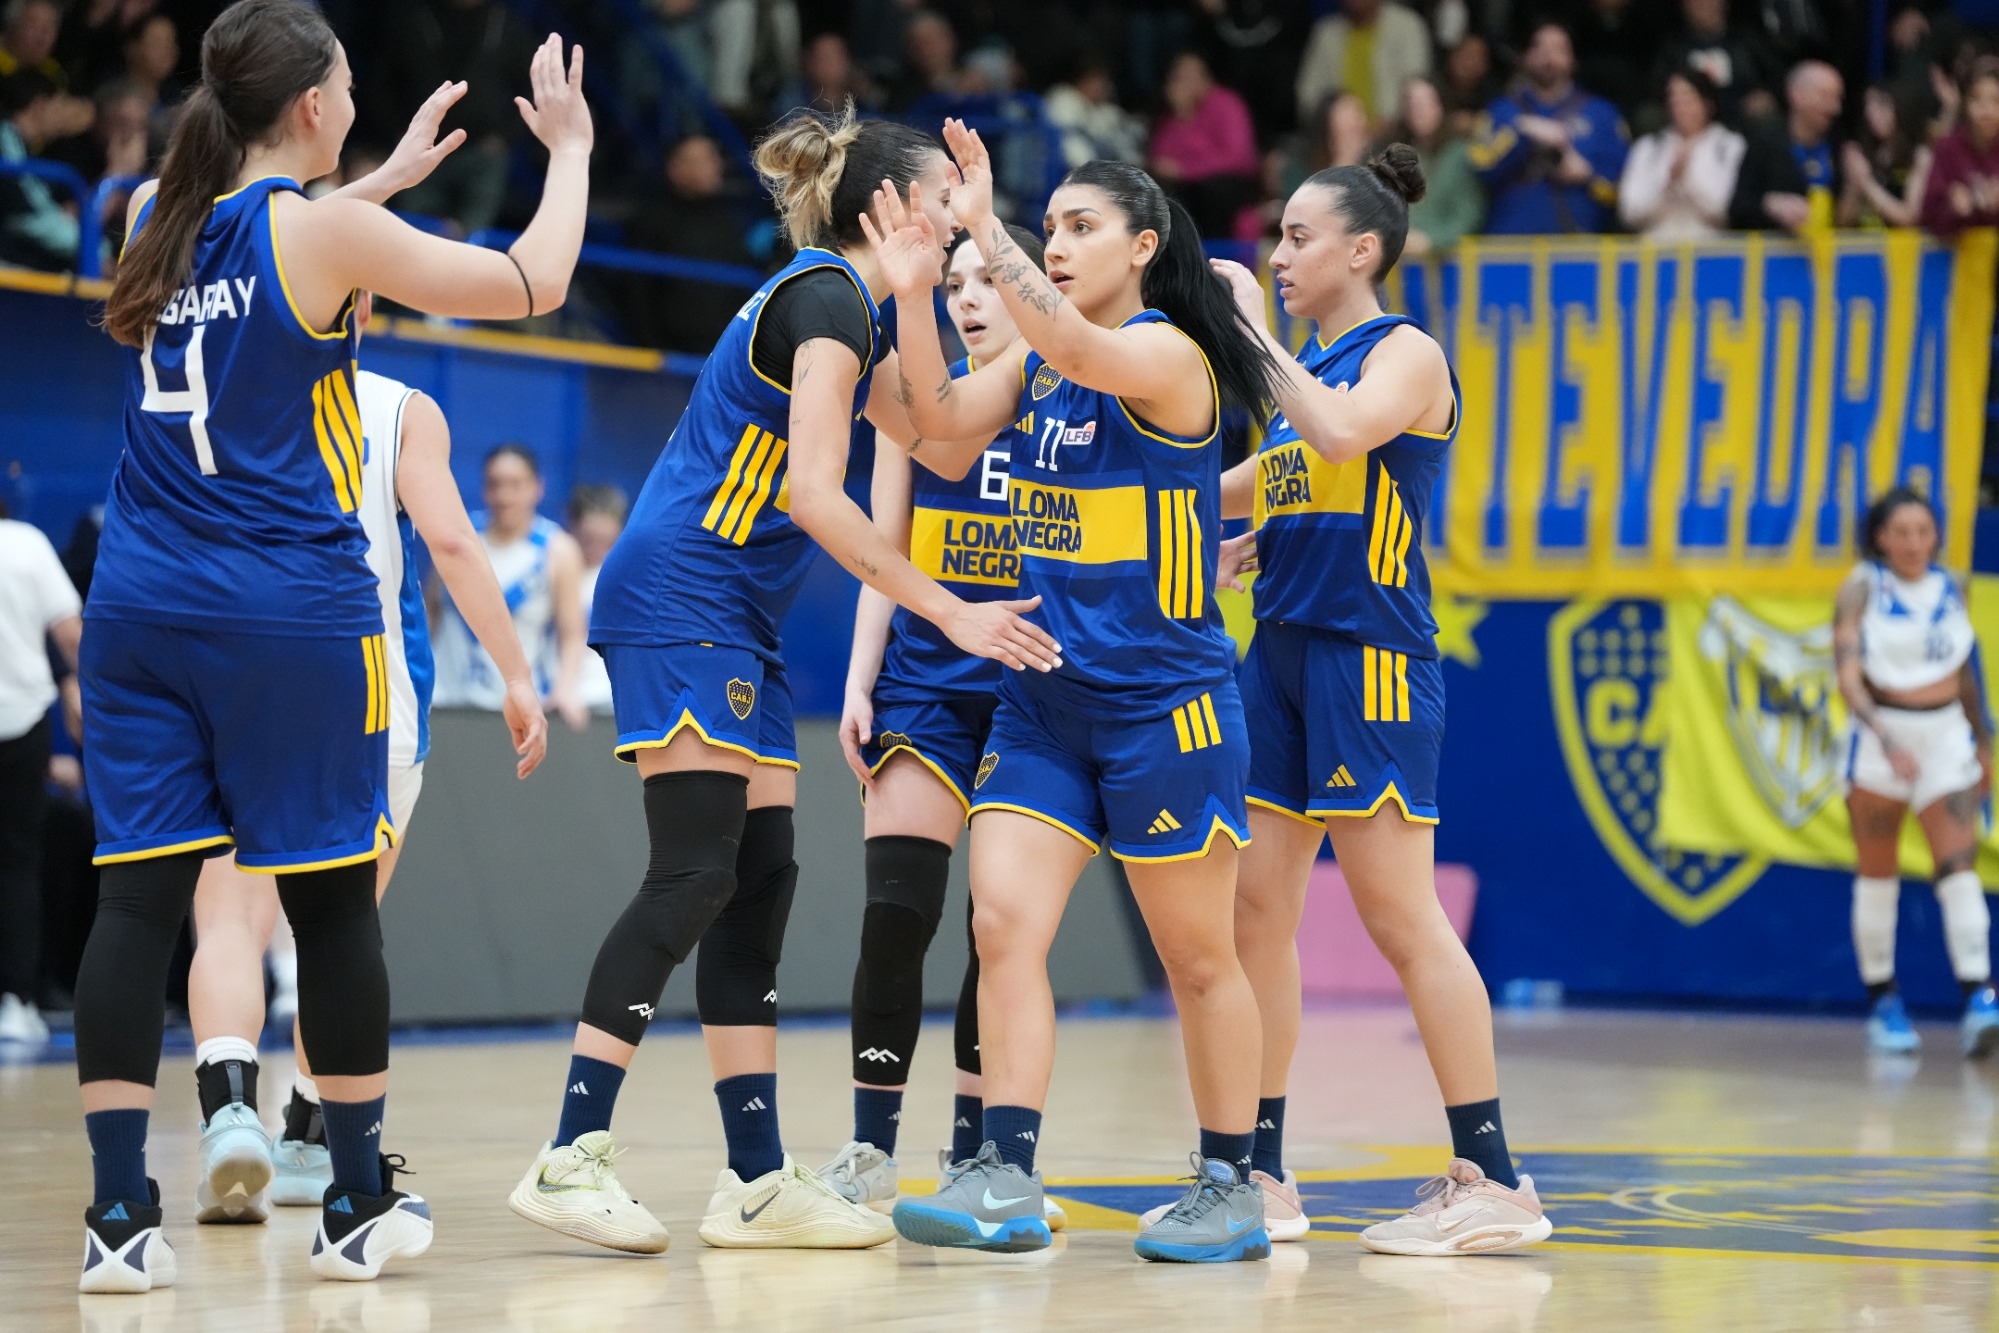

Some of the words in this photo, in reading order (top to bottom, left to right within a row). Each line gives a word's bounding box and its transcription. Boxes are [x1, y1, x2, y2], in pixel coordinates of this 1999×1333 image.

[156, 275, 257, 326] GARAY
[1036, 375, 1057, 387] CABJ
[140, 324, 219, 476] 4
[1035, 416, 1066, 472] 11
[1065, 431, 1093, 443] LFB
[979, 450, 1011, 502] 6
[1261, 447, 1309, 486] LOMA
[1012, 487, 1081, 523] LOMA
[944, 518, 1018, 551] LOM
[1012, 519, 1083, 554] NEGRA
[941, 548, 1020, 580] NEGR
[730, 691, 751, 704] CABJ
